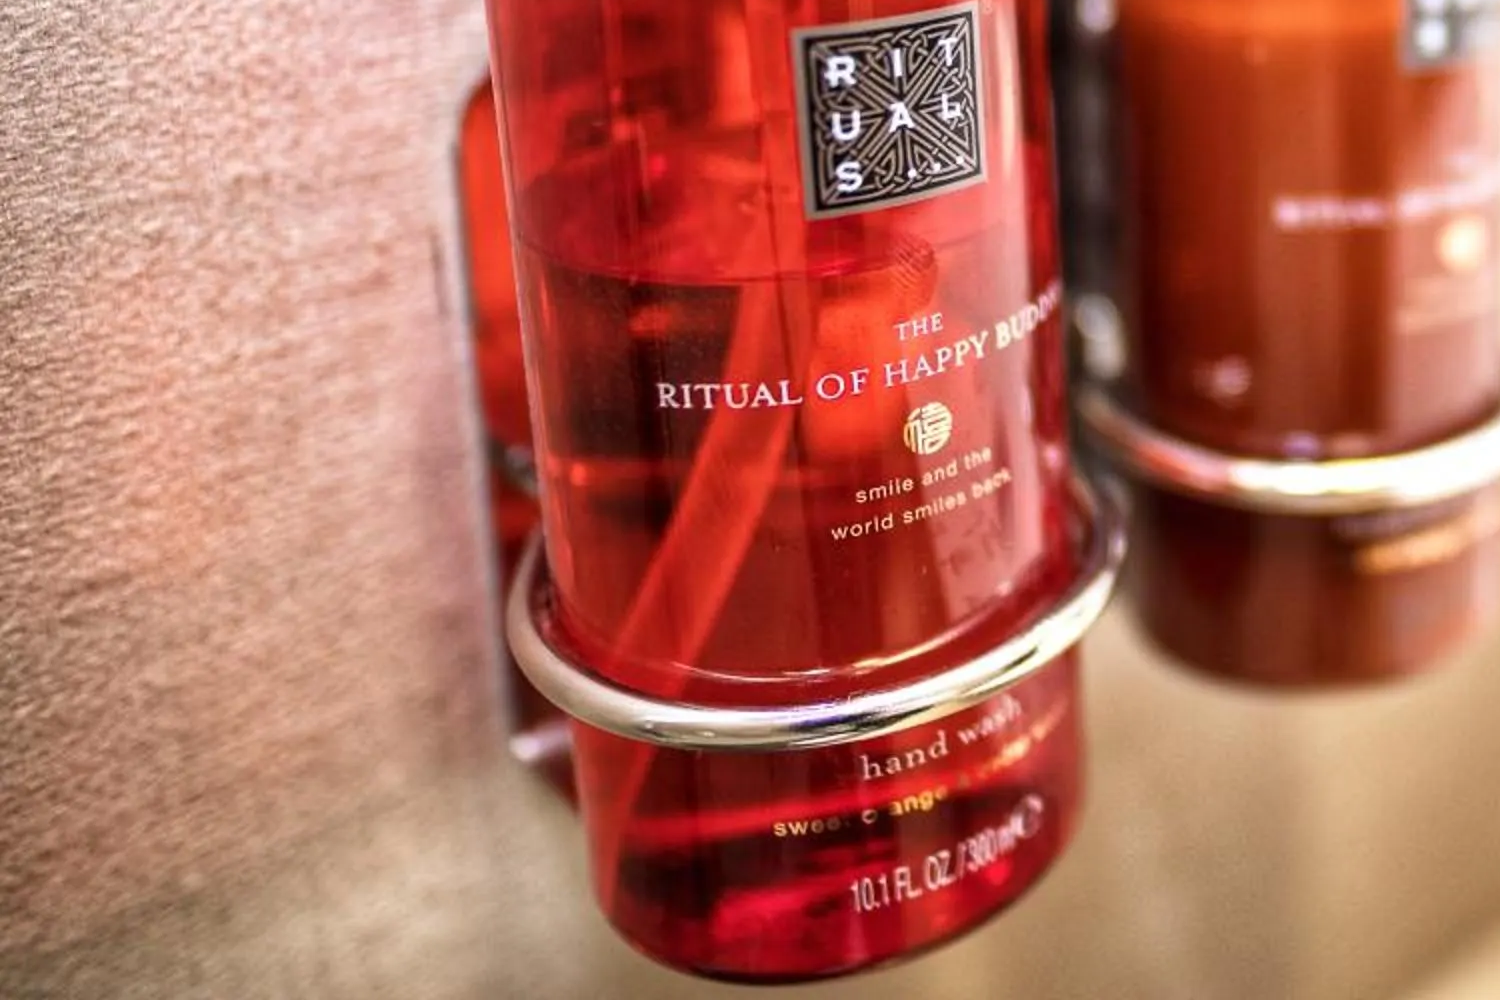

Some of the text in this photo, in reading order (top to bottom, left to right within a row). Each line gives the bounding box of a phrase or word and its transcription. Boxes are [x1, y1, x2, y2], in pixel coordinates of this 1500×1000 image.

[892, 311, 945, 342] THE
[655, 379, 804, 410] RITUAL
[815, 367, 870, 401] OF
[883, 329, 989, 388] HAPPY
[854, 446, 993, 504] smile and the
[830, 466, 1013, 541] world smiles back
[859, 729, 950, 781] hand
[849, 872, 890, 914] 10.1
